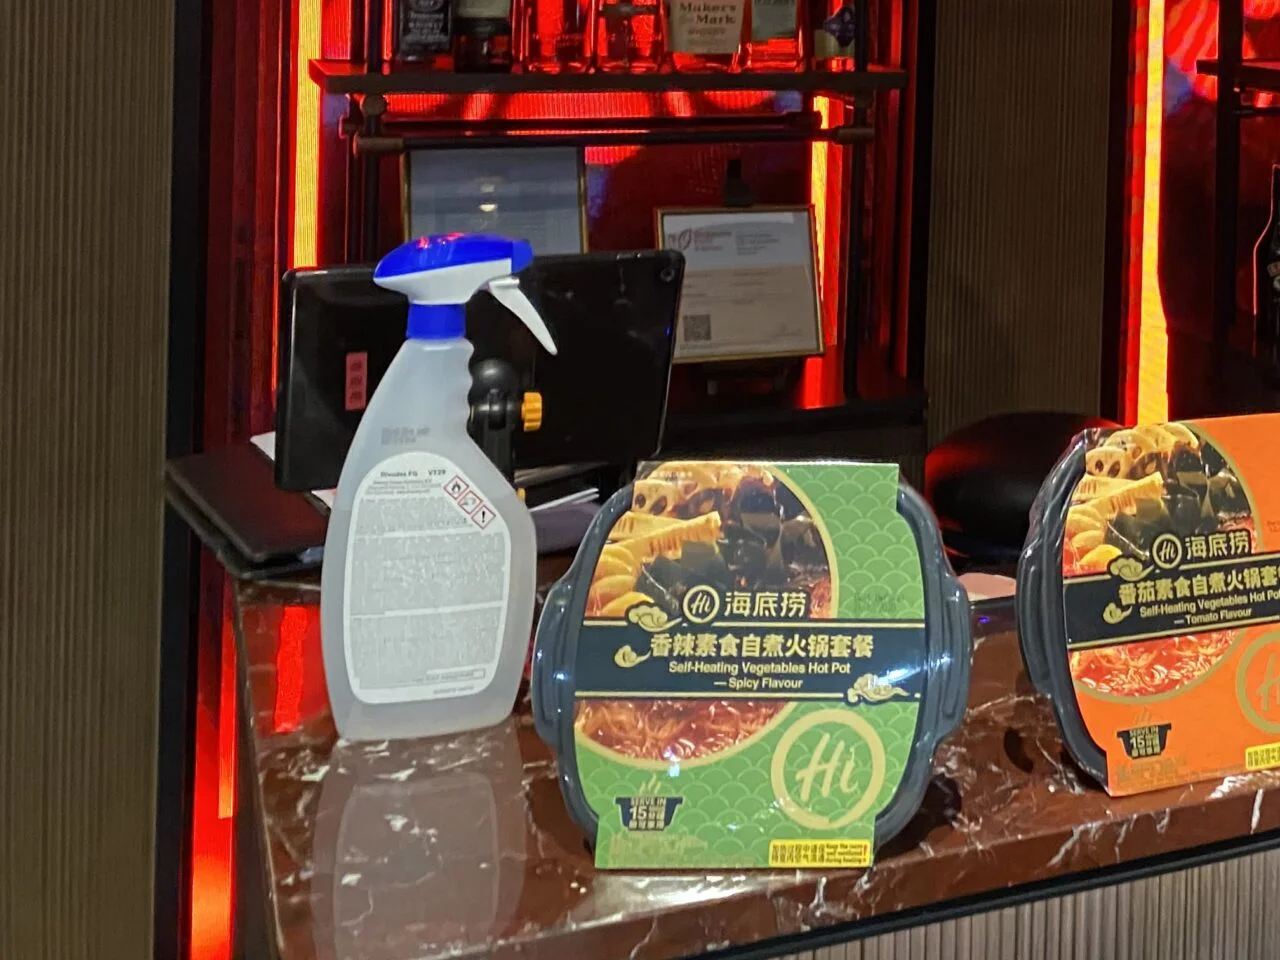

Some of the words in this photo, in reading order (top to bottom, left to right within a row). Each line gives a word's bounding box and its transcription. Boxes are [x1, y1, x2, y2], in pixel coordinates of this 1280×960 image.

[696, 13, 736, 25] Mark
[1184, 531, 1250, 560] 海底捞
[724, 591, 807, 618] 海底捞
[1139, 602, 1197, 618] Self-Heating
[1197, 594, 1248, 611] Vegetables
[1249, 591, 1266, 603] Hot
[1185, 613, 1219, 625] Tomato
[1220, 608, 1252, 621] Flavour
[651, 633, 874, 658] 香辣素食自煮火锅套餐
[669, 661, 738, 676] Self-Heating
[742, 661, 805, 676] Vegetables
[808, 662, 828, 674] Hot
[831, 662, 851, 674] Pot
[728, 677, 759, 690] Spicy
[762, 677, 803, 689] Flavour
[795, 733, 859, 801] Hi
[629, 805, 647, 820] 15
